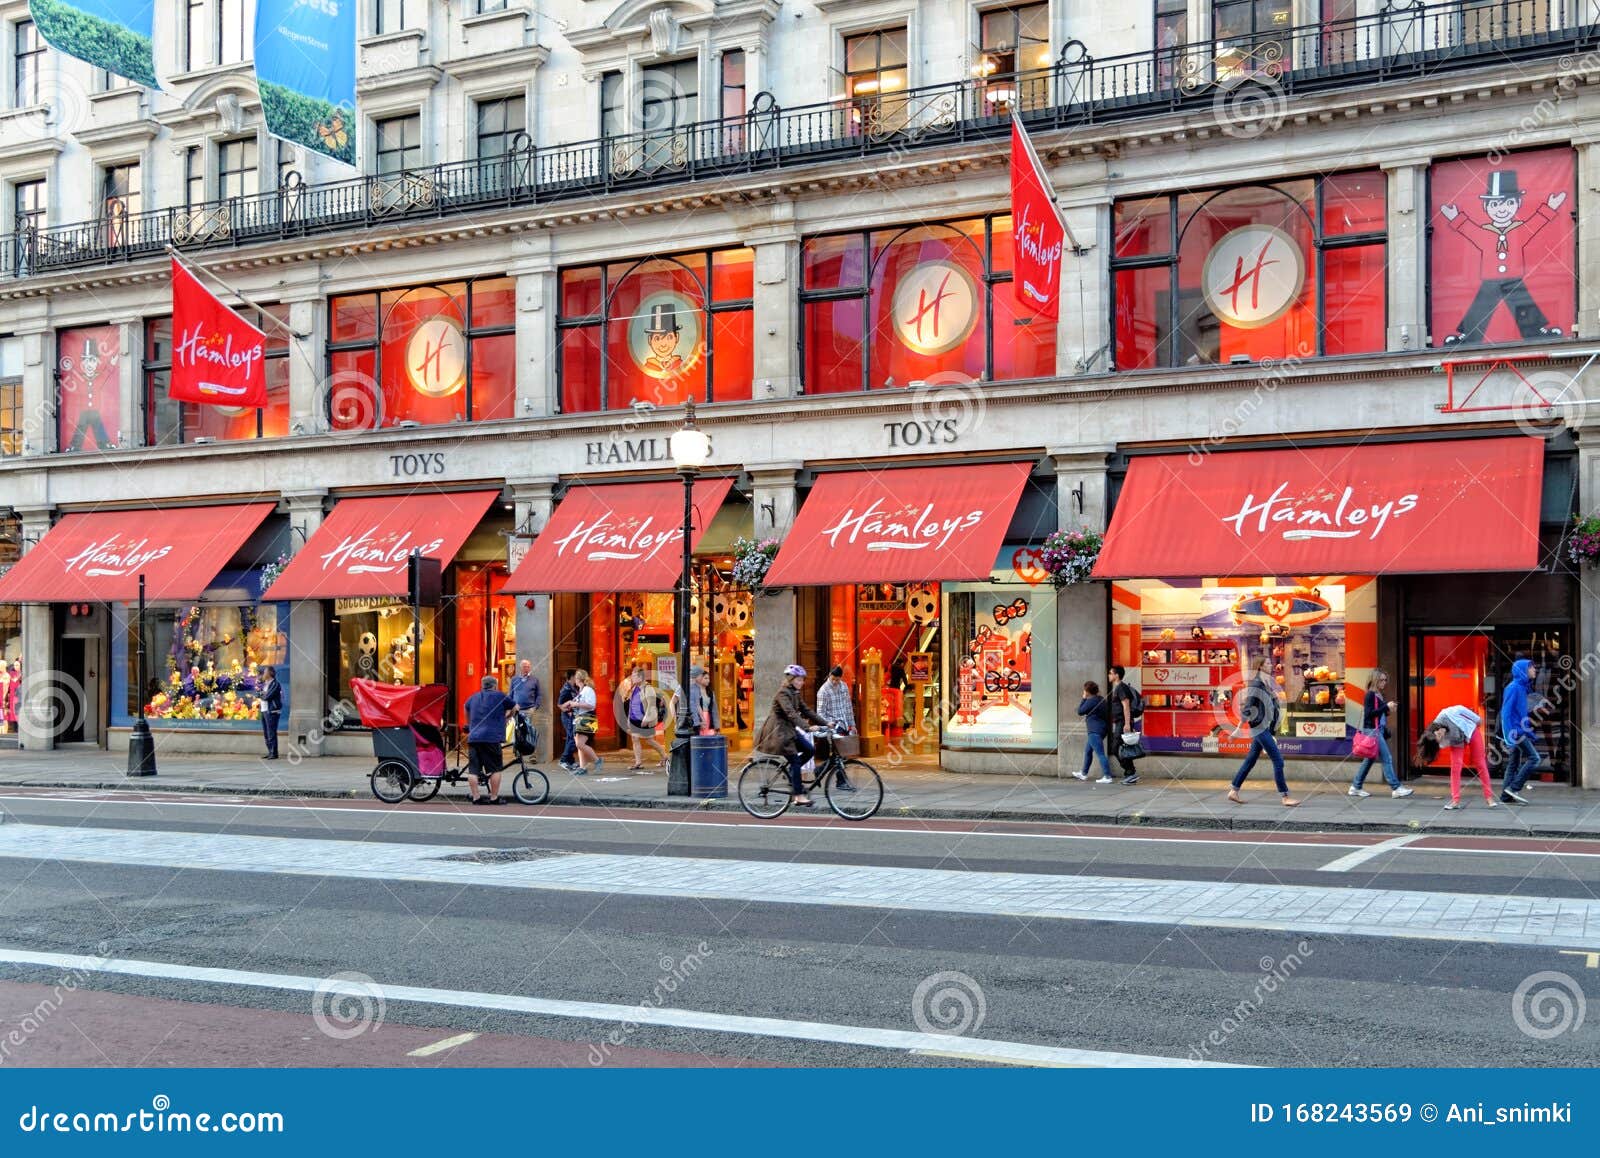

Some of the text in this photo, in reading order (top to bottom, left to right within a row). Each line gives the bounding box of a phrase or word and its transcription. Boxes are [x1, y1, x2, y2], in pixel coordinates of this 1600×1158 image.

[1014, 203, 1061, 284] Hamleys
[1219, 236, 1280, 315] H
[905, 270, 961, 343] H
[176, 321, 262, 380] Hamleys
[416, 325, 452, 387] H
[585, 433, 713, 465] HAMLS
[883, 419, 959, 447] TOYS
[390, 452, 445, 476] TOYS
[821, 497, 984, 550] Hamleys
[1222, 481, 1419, 540] Hamleys
[65, 533, 173, 577] Hamleys
[1264, 596, 1290, 617] ty
